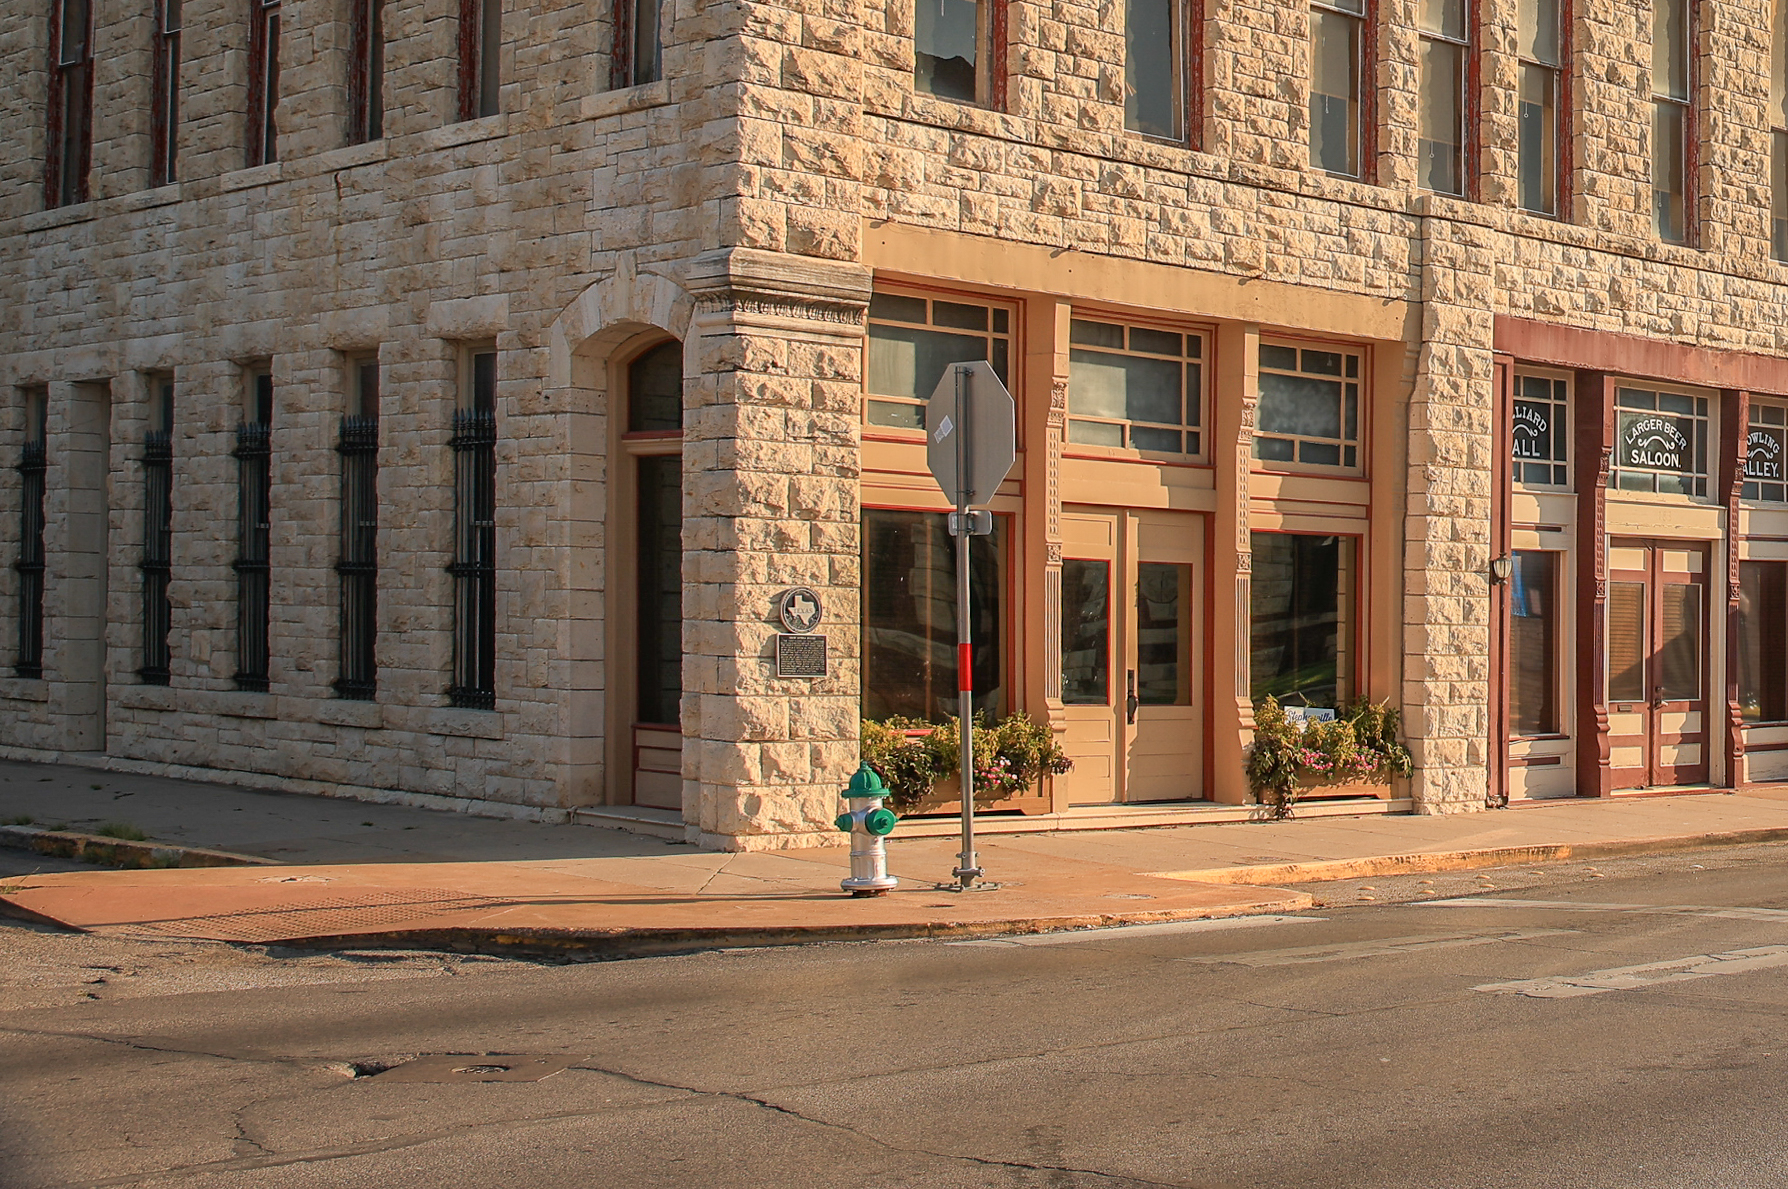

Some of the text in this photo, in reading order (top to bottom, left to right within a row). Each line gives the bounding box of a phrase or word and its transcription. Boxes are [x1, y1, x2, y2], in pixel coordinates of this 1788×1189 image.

[1625, 419, 1687, 450] LARGER BEER
[1746, 431, 1780, 454] OWLING
[1512, 438, 1541, 457] ALL
[1630, 449, 1682, 469] SALOON.
